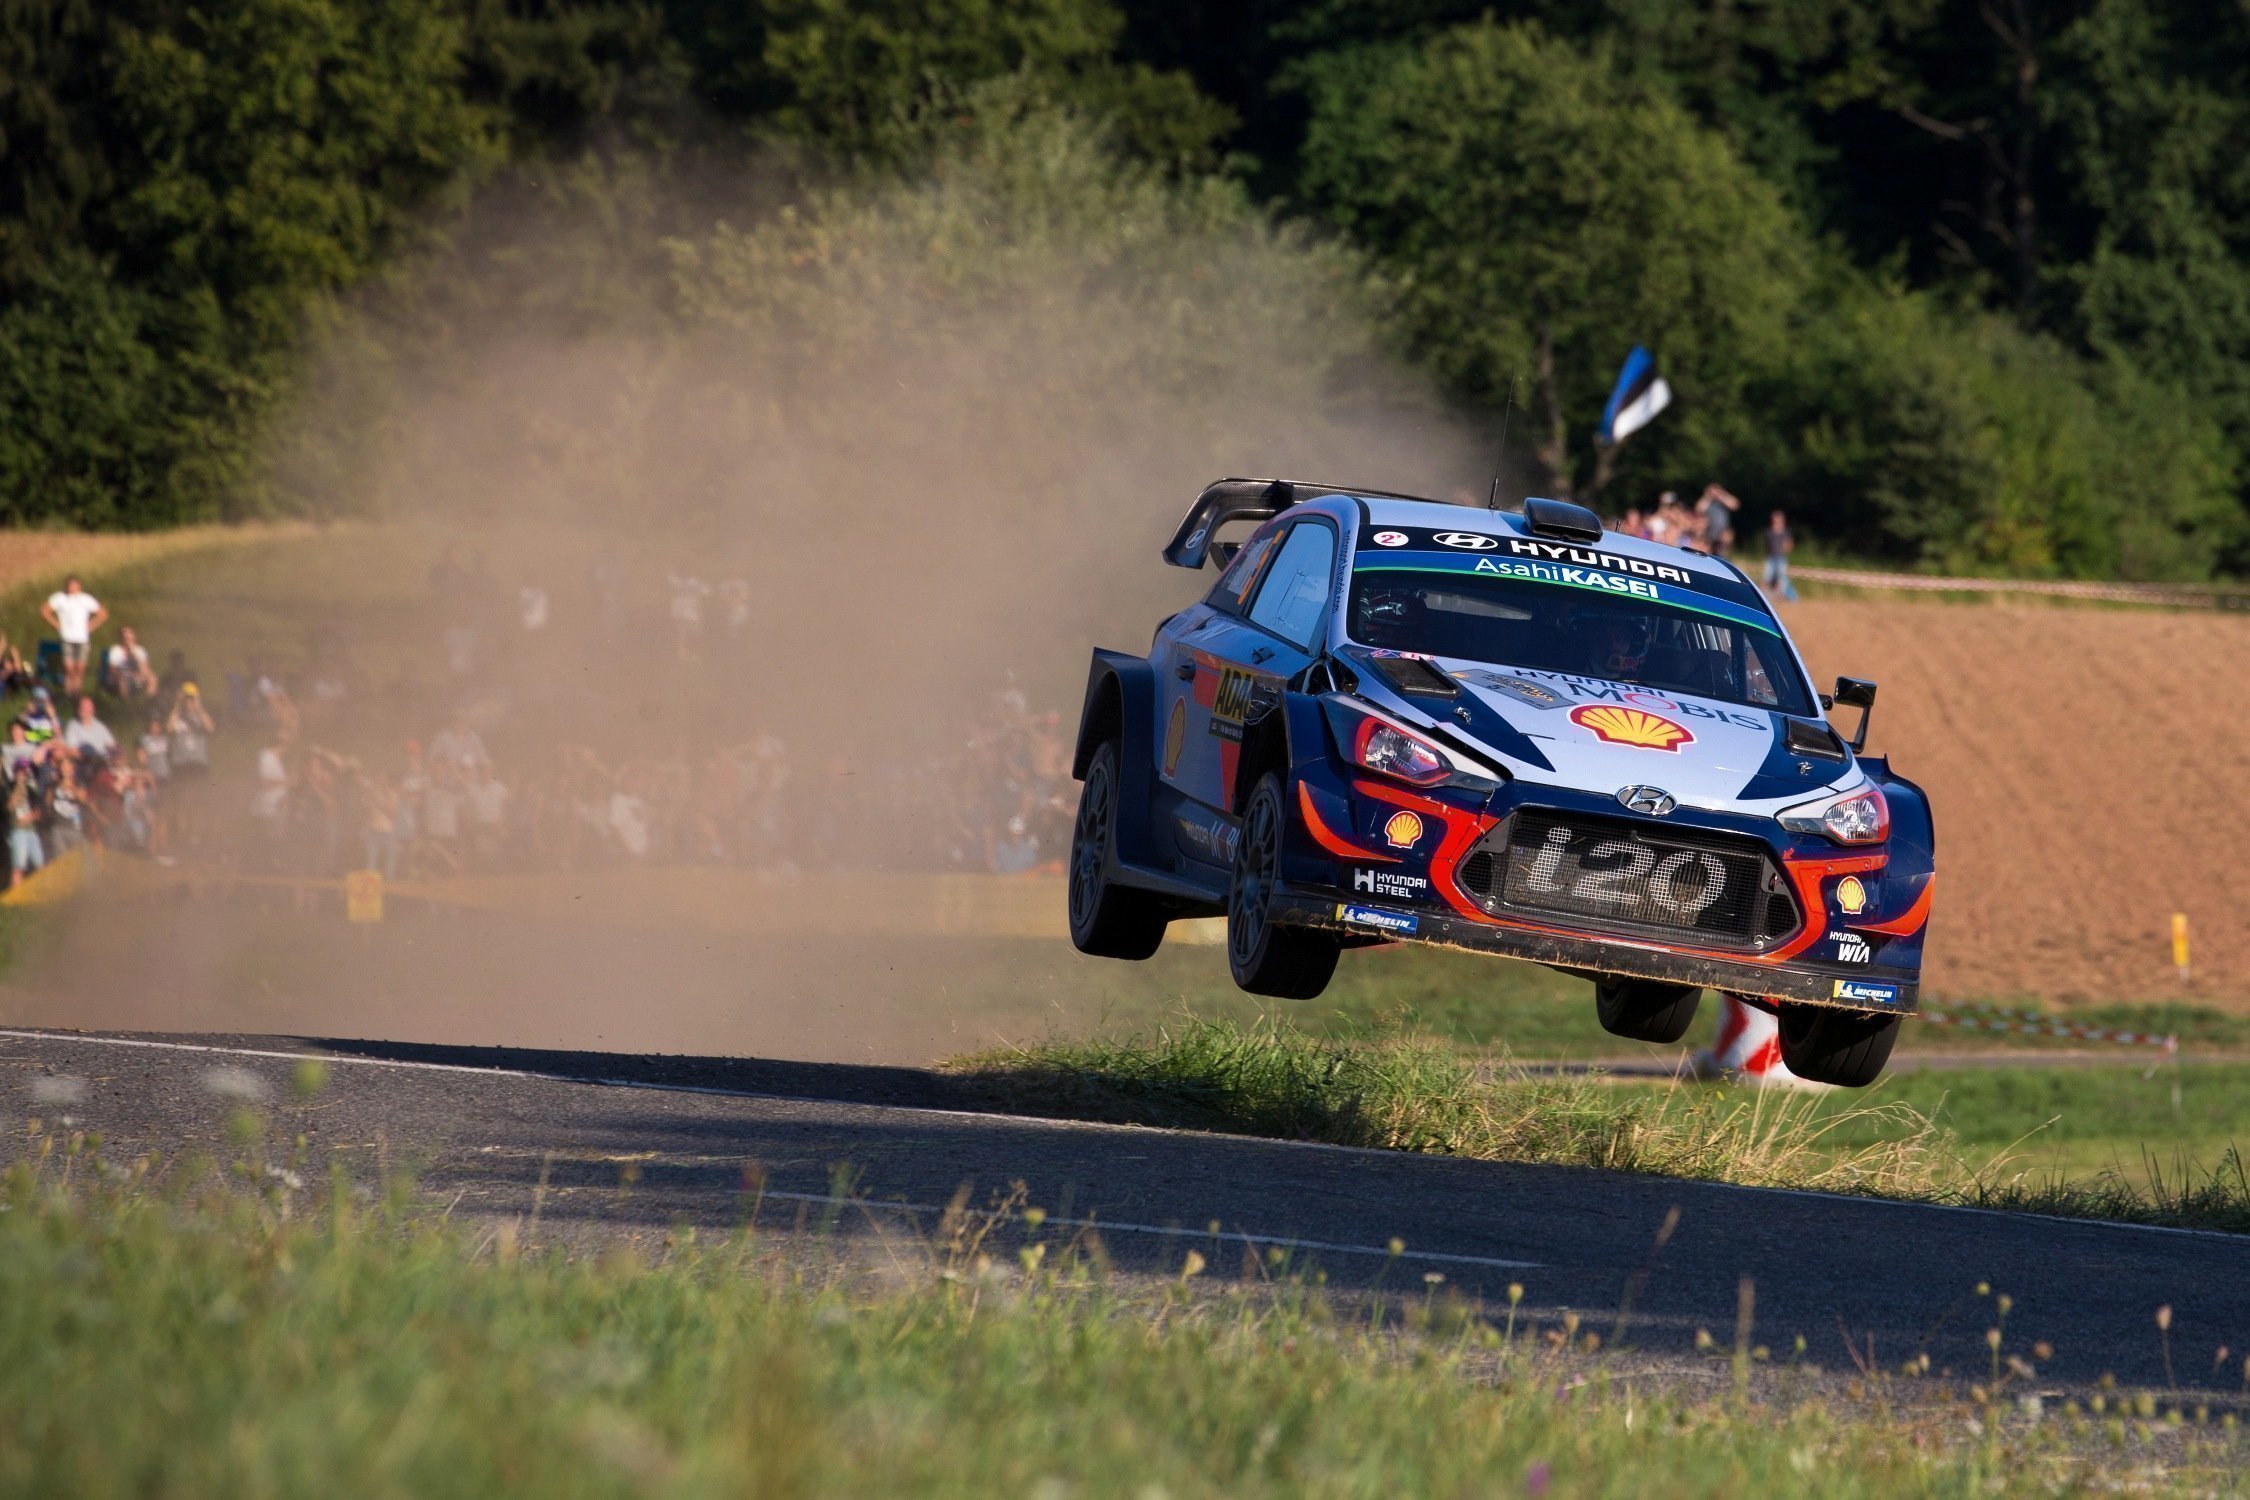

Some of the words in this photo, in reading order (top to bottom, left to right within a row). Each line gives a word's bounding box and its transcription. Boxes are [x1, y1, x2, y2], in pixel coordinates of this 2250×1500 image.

[1510, 540, 1691, 584] HYUNDAI
[1474, 558, 1659, 599] AsahiKASEI
[1513, 669, 1666, 698] HYUNDAI
[1566, 682, 1768, 731] MOBIS
[1376, 872, 1427, 889] HYUNDAI
[1526, 826, 1727, 912] i20
[1376, 884, 1412, 898] STEEL
[1829, 931, 1862, 944] HYUNDAI
[1838, 941, 1870, 963] WIA
[1853, 987, 1893, 998] MICHELIN
